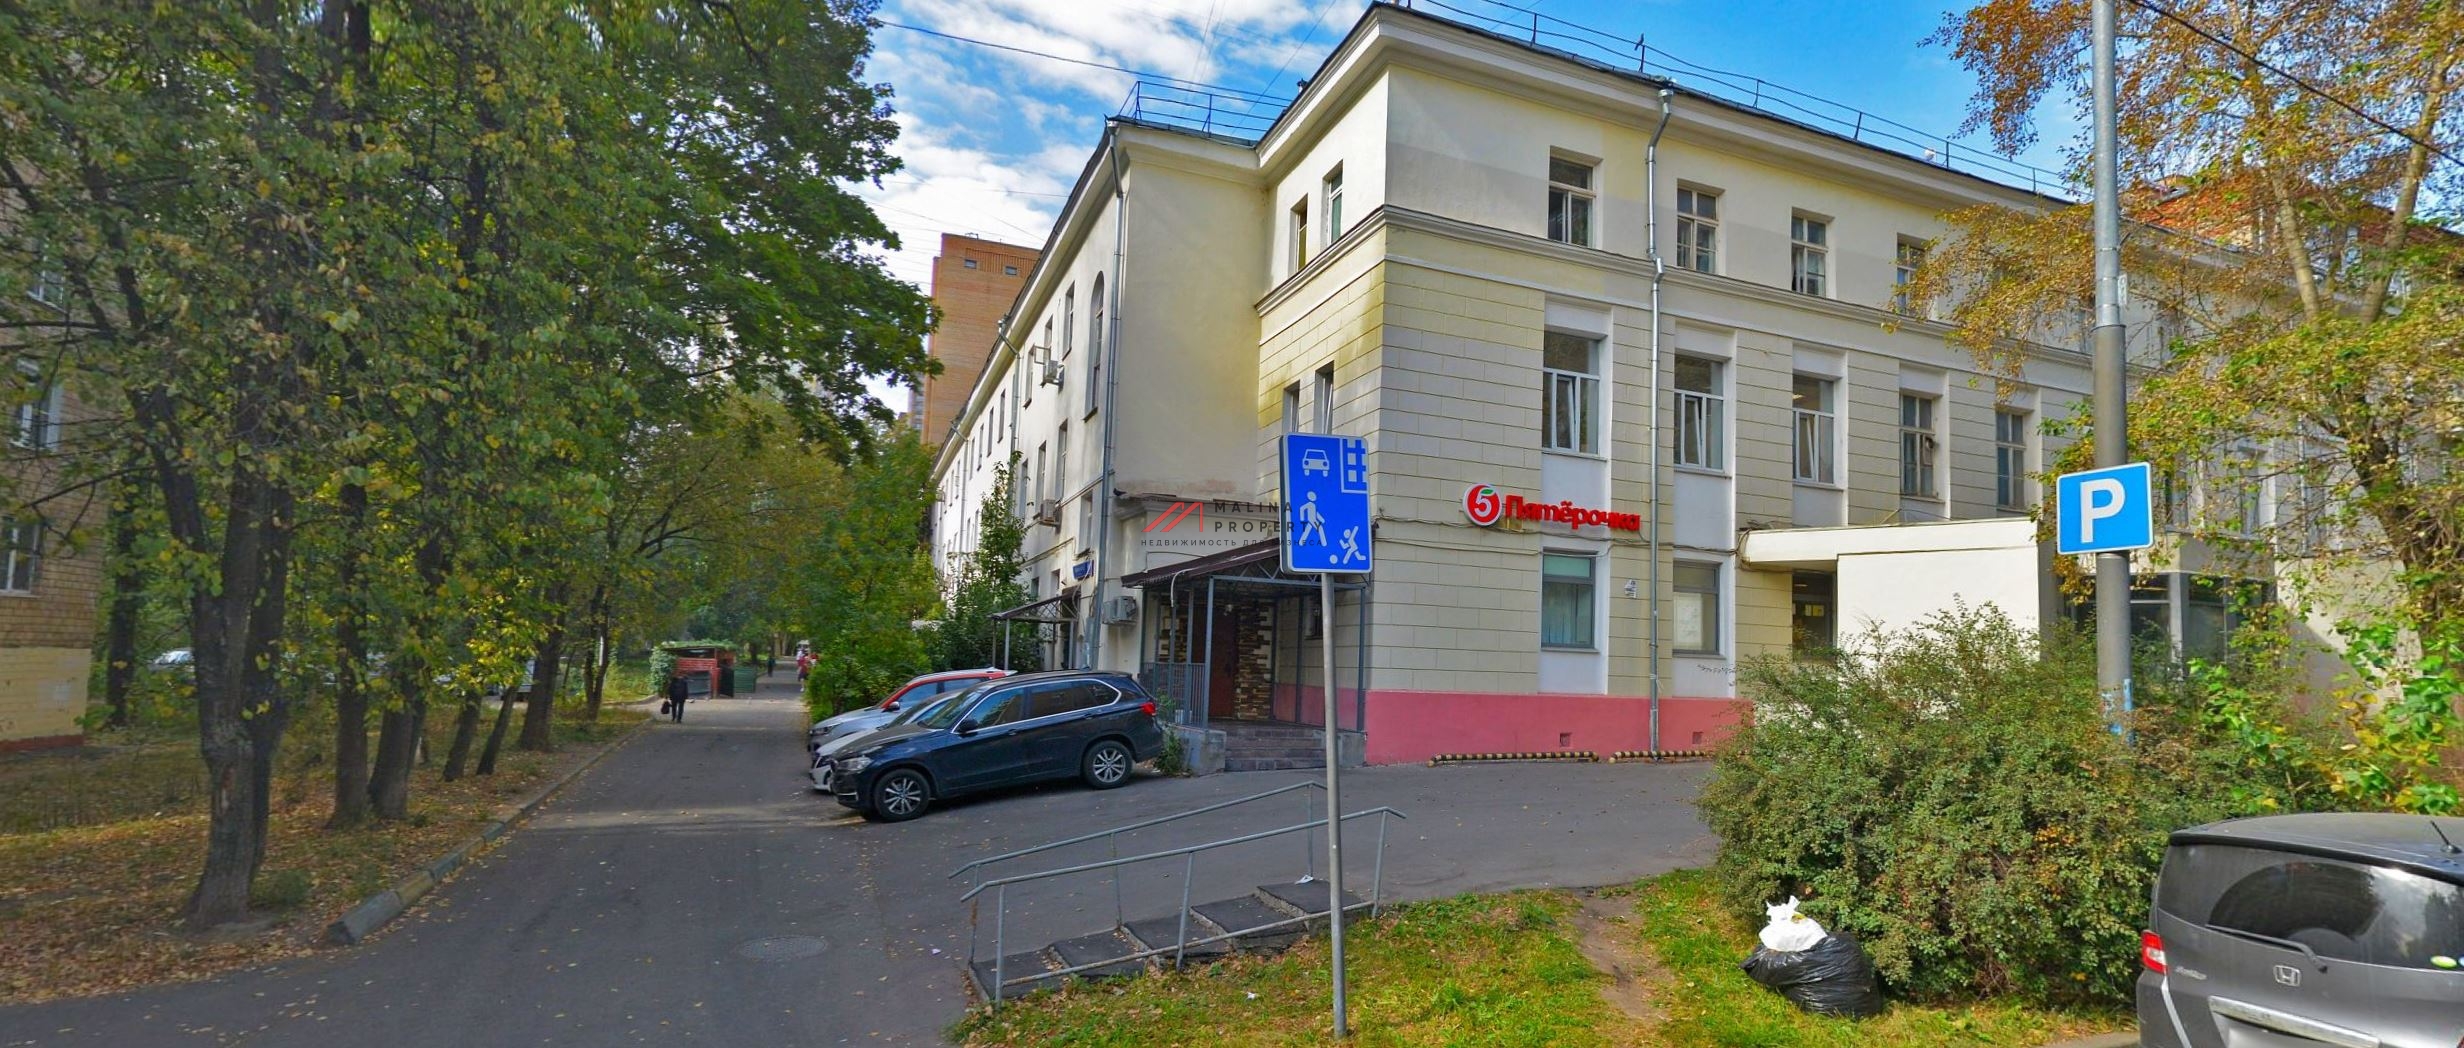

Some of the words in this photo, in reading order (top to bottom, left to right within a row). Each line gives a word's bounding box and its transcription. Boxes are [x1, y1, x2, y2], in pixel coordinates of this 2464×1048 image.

[1473, 489, 1493, 517] 5
[1505, 494, 1641, 531] Пятёрочка
[2080, 478, 2126, 544] P
